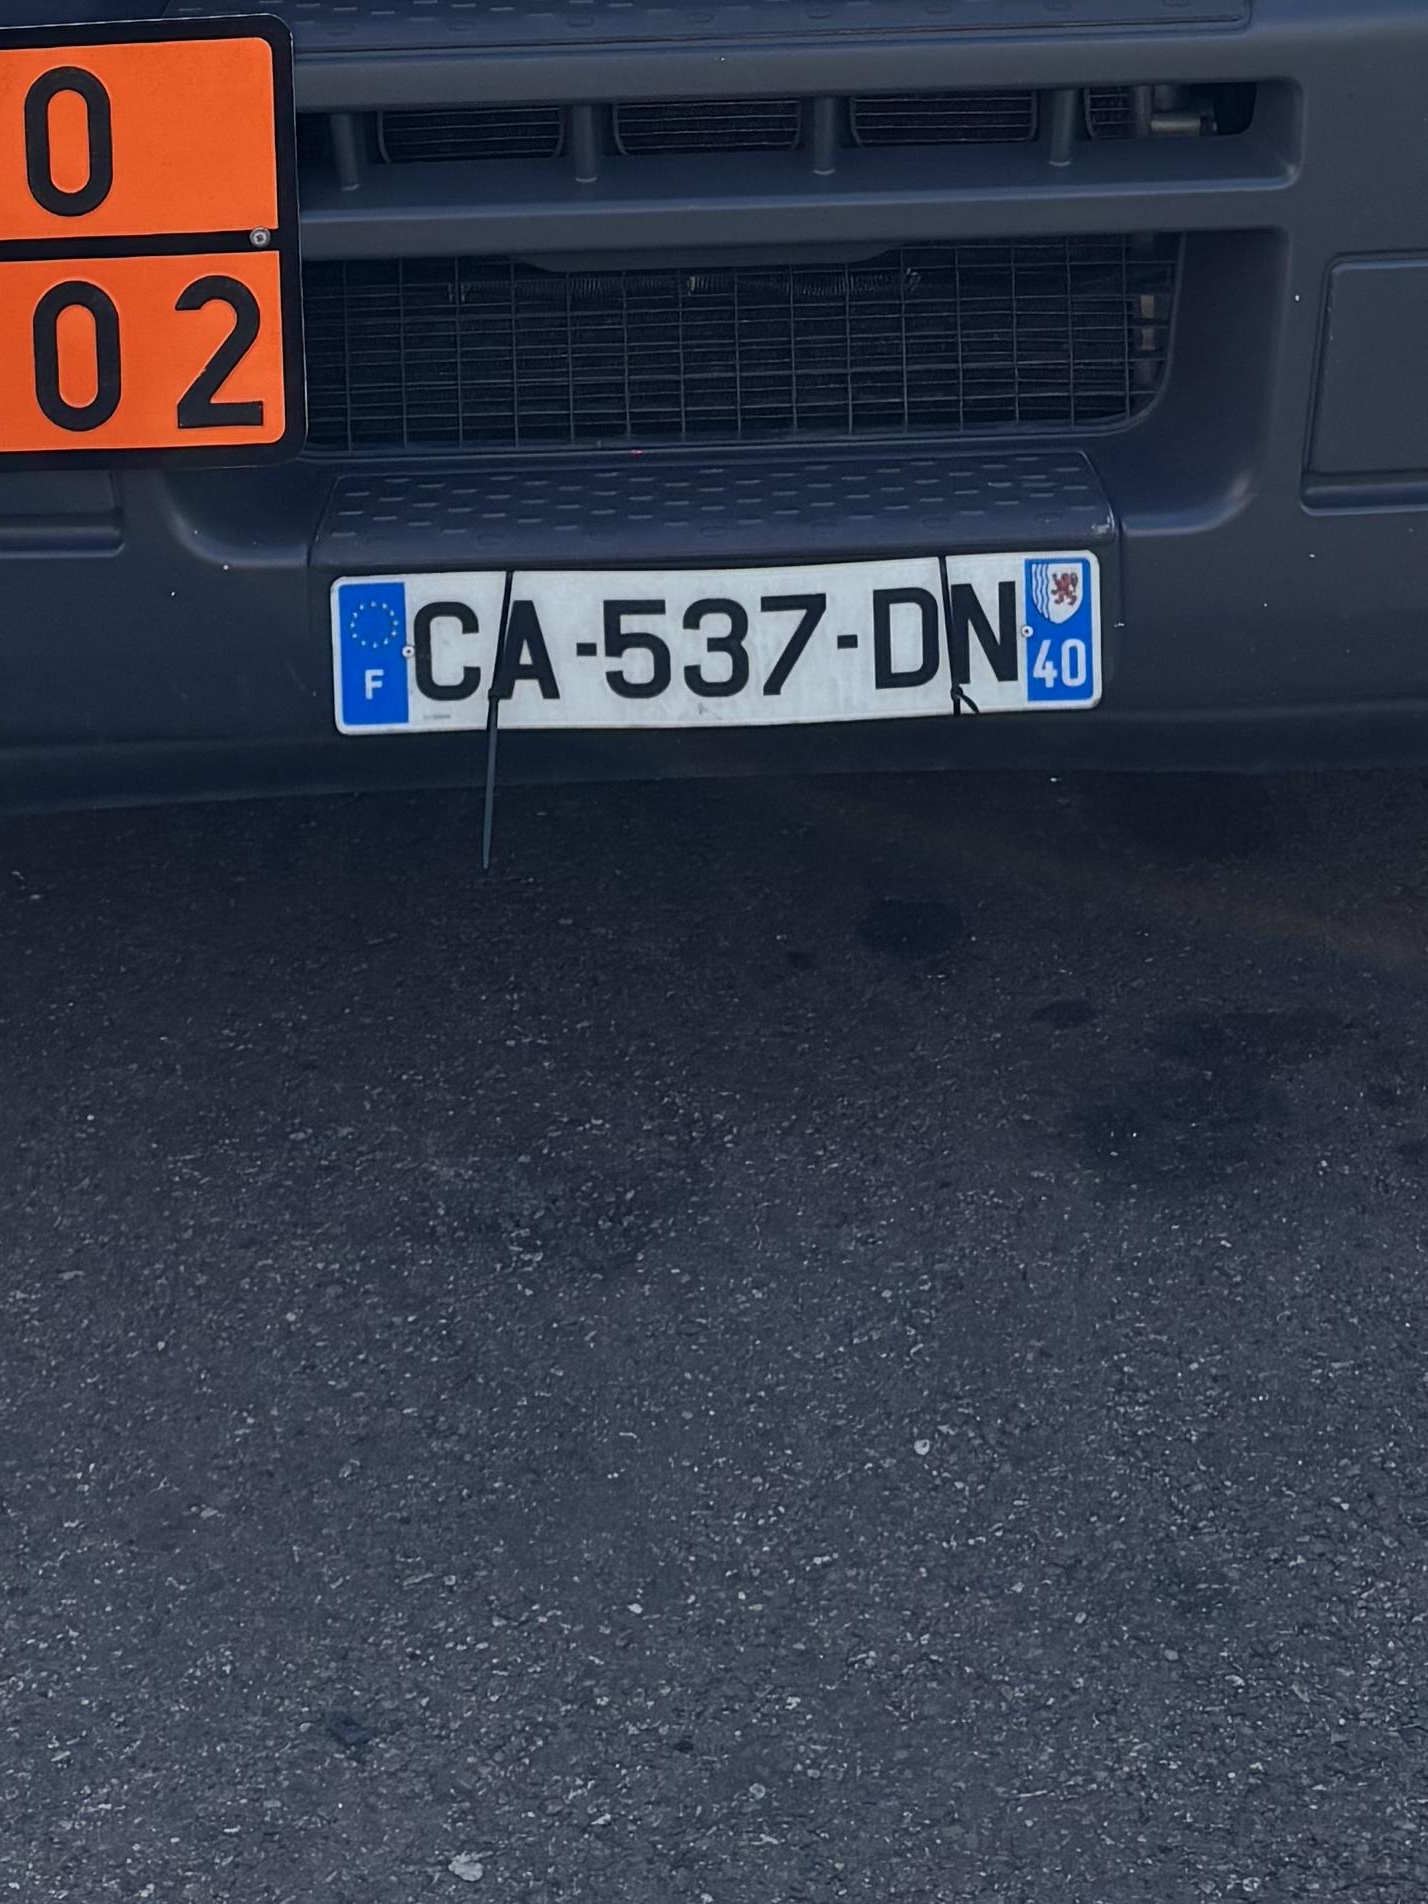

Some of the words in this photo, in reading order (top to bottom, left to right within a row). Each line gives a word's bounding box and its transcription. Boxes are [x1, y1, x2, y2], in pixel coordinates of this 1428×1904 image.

[365, 670, 384, 701] F
[413, 582, 1019, 701] CA-537-DN
[1032, 637, 1087, 689] 40
